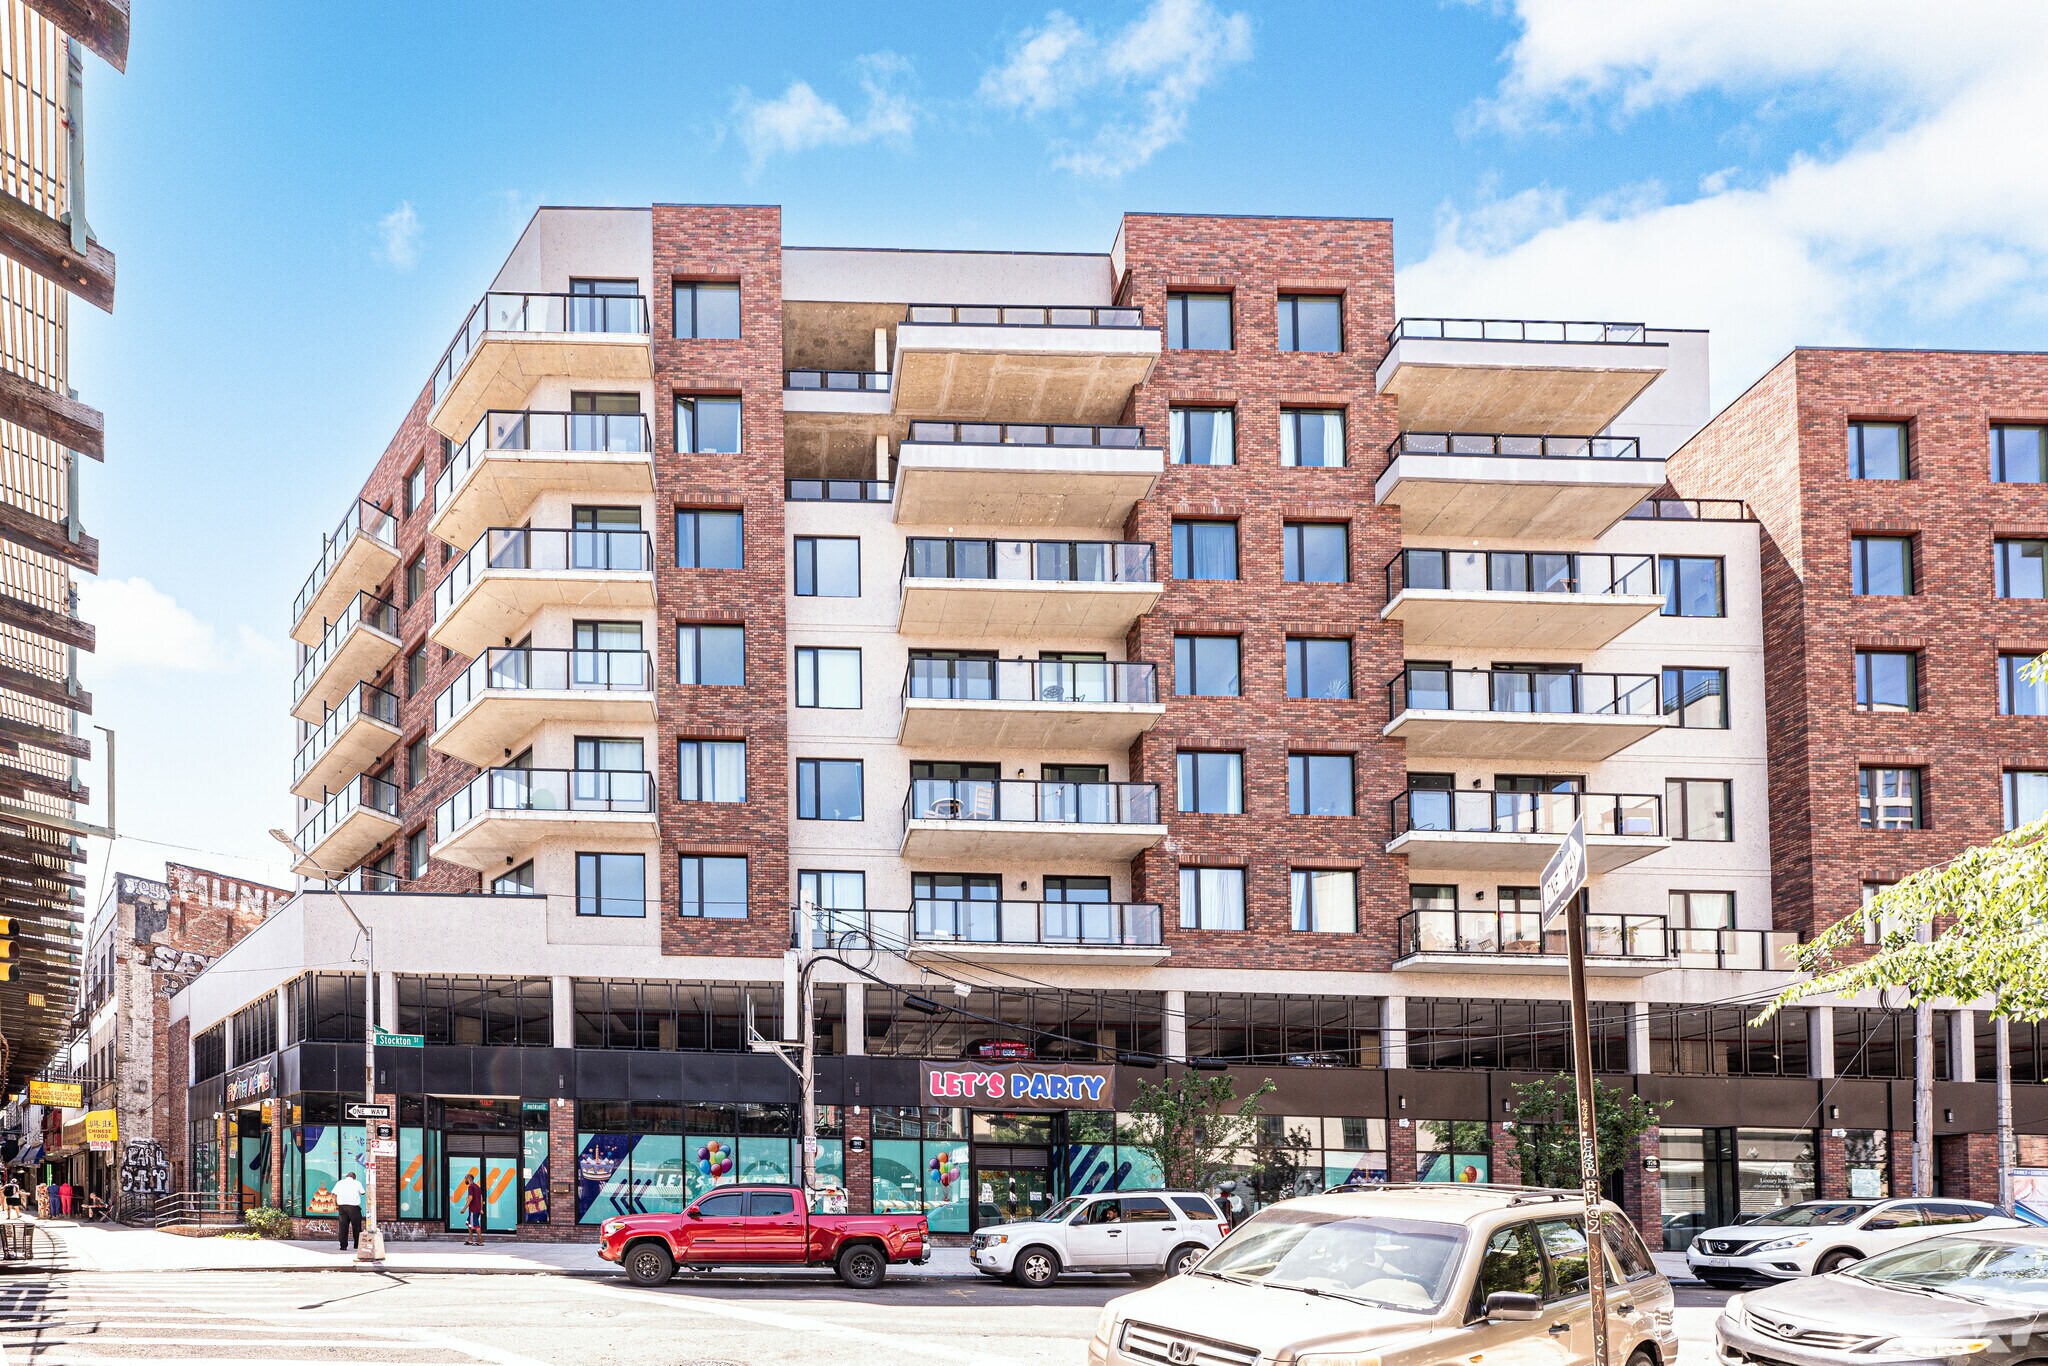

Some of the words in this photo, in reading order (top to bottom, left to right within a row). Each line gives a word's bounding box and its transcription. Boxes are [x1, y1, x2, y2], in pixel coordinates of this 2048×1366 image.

[1546, 872, 1560, 905] ONE
[1563, 848, 1579, 884] WAY
[379, 1035, 411, 1046] Stockton
[413, 1036, 419, 1044] St
[930, 1071, 1005, 1098] LET'S
[1011, 1073, 1106, 1100] PARTY
[656, 1173, 705, 1189] LET'S
